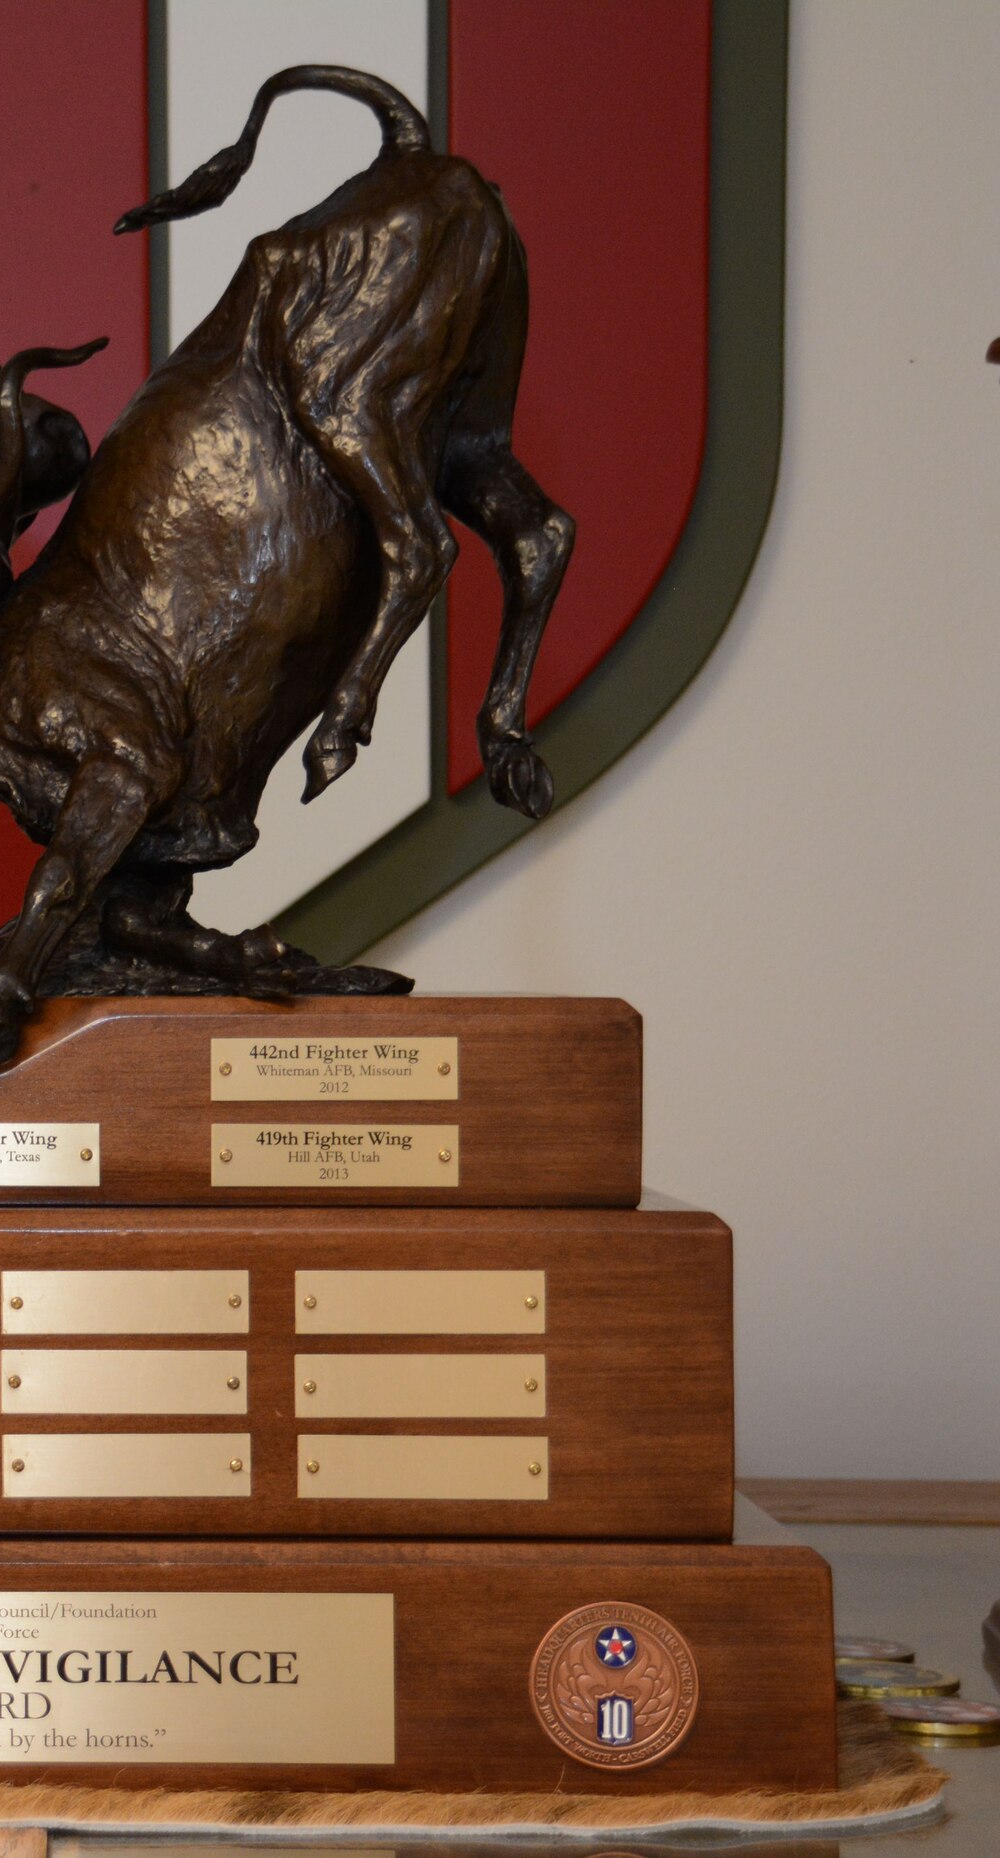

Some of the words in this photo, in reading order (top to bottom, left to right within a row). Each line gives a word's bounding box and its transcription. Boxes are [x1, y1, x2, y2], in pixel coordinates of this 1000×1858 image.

[249, 1045, 300, 1060] 442nd
[305, 1045, 368, 1064] Fighter
[373, 1045, 419, 1064] Wing
[256, 1065, 319, 1076] Whiteman
[323, 1065, 355, 1078] AFB,
[359, 1065, 412, 1076] Missouri
[320, 1081, 349, 1093] 2012
[11, 1131, 57, 1150] Wing
[256, 1131, 298, 1146] 419th
[303, 1131, 364, 1150] Fighter
[367, 1131, 413, 1150] Wing
[6, 1150, 40, 1161] Texas
[288, 1151, 310, 1163] Hill
[314, 1151, 346, 1165] AFB,
[351, 1151, 380, 1163] Utah
[319, 1168, 349, 1180] 2013
[600, 1699, 629, 1739] 10
[9, 1728, 35, 1754] by
[43, 1728, 77, 1747] the
